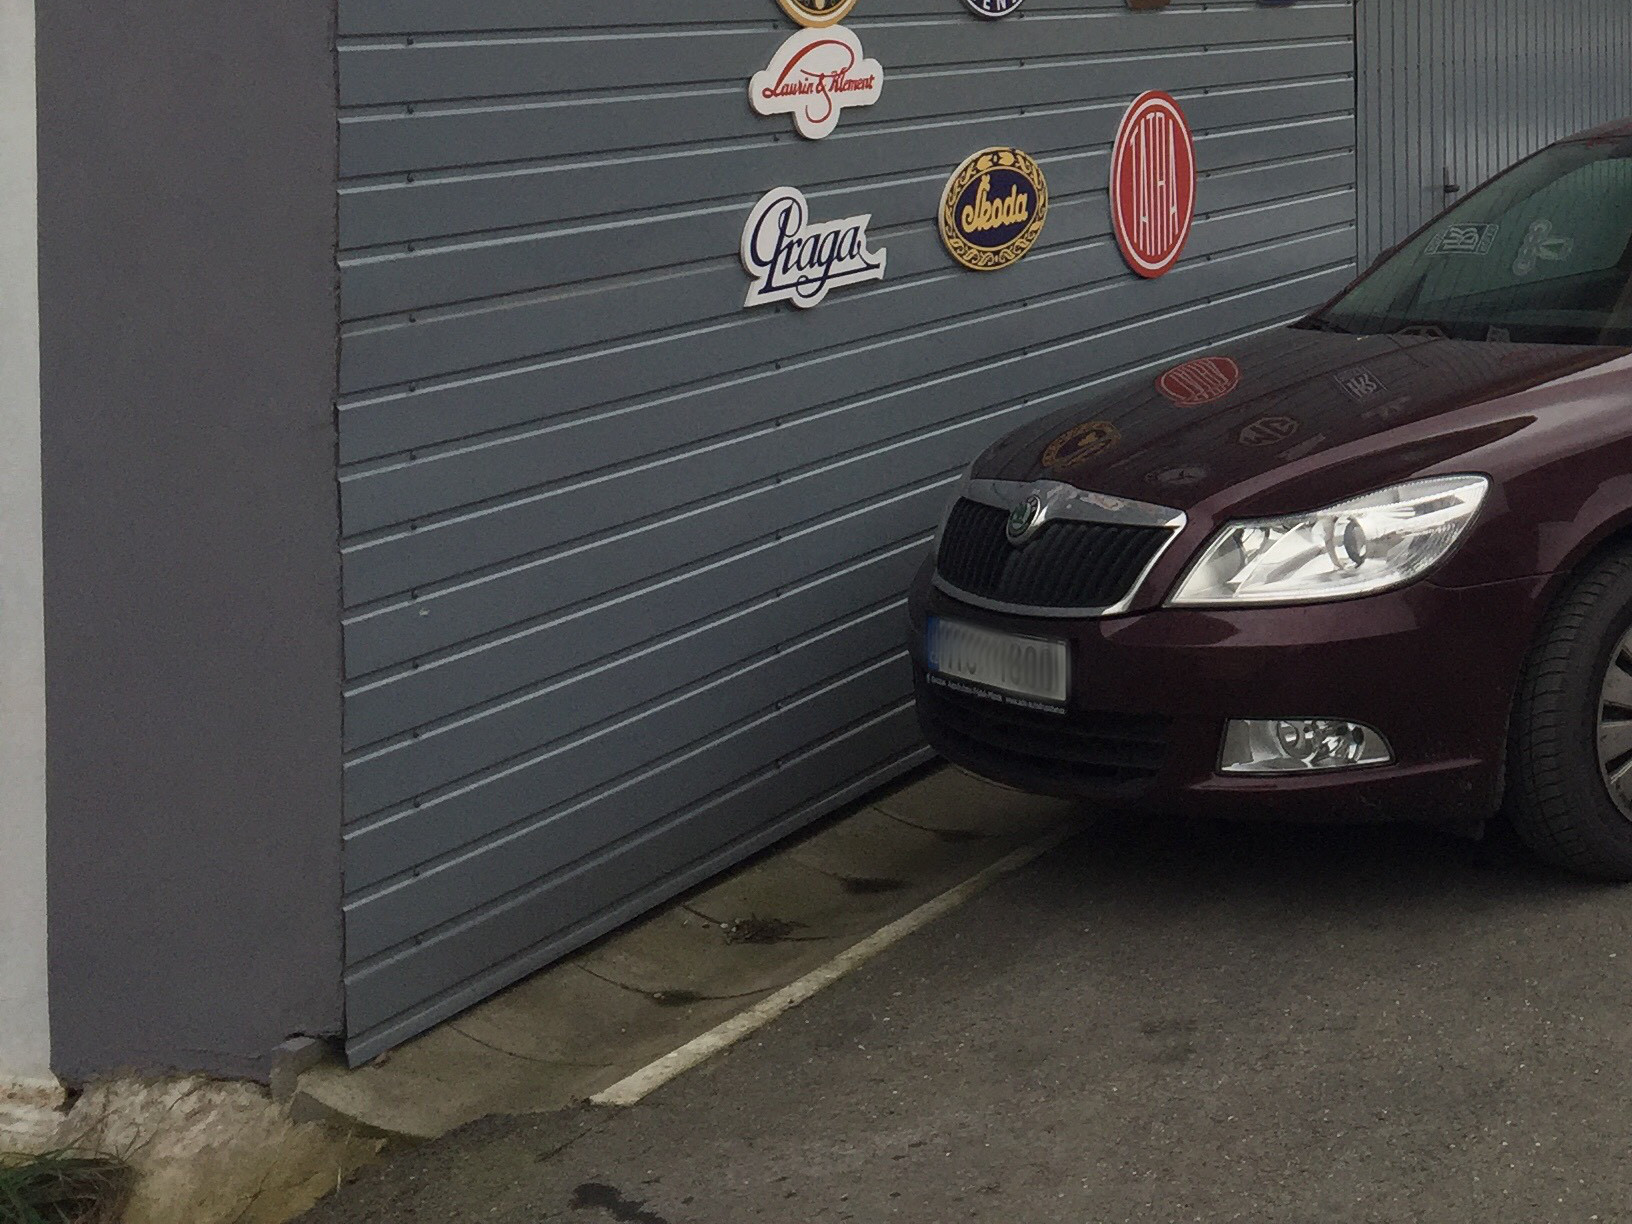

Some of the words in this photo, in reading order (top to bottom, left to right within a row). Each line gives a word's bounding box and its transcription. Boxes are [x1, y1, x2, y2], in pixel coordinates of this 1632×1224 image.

[805, 72, 833, 123] &
[828, 66, 875, 94] Klement
[961, 174, 1029, 234] Škoda
[1129, 111, 1181, 256] TATRA
[751, 196, 881, 298] Praga
